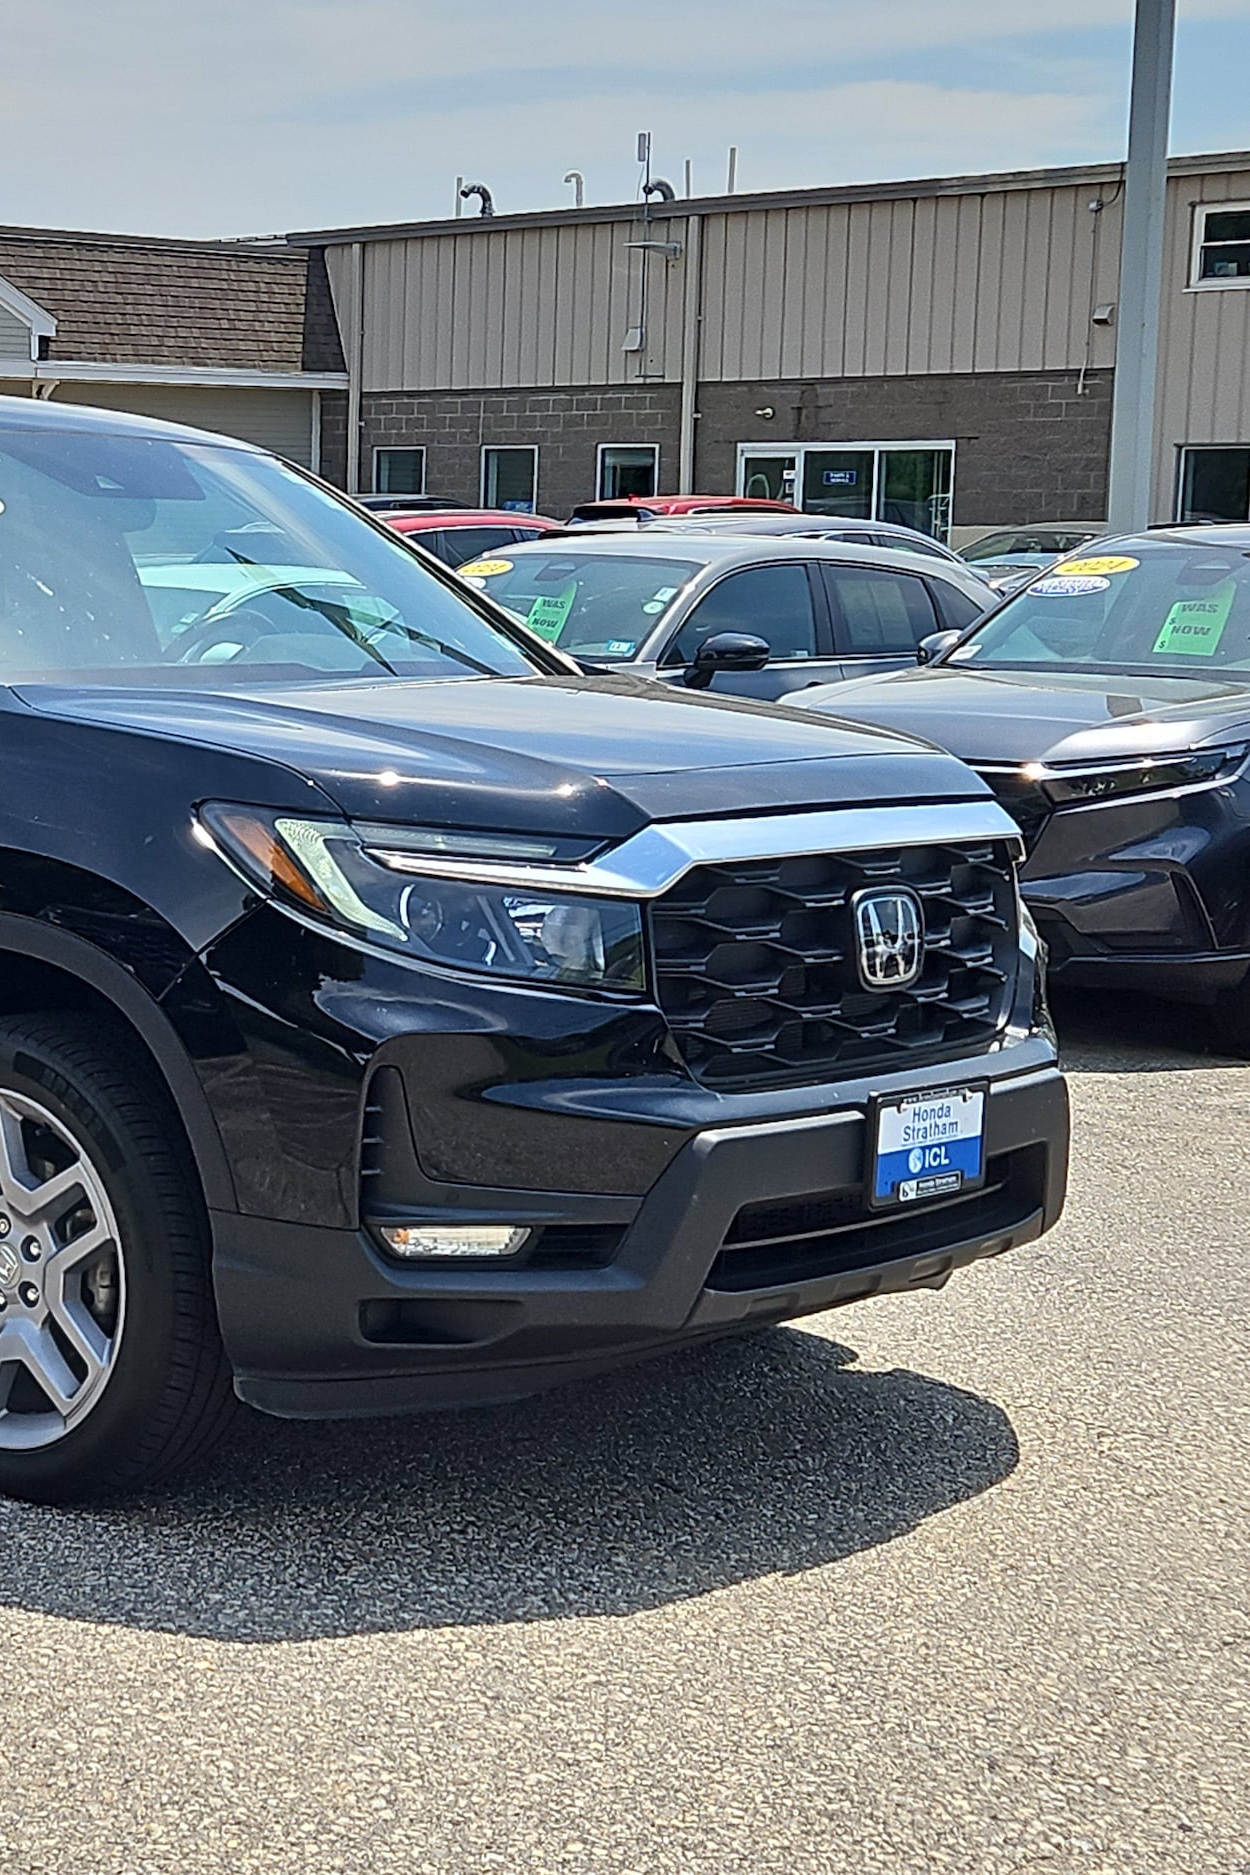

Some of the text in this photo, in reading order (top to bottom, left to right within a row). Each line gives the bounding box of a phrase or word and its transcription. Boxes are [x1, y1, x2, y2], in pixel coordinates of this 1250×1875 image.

[541, 599, 566, 609] WAS
[1181, 603, 1219, 613] WAS
[532, 617, 558, 628] NOW
[1171, 625, 1211, 635] NOW
[912, 1102, 951, 1123] Honda
[903, 1121, 959, 1142] Stratham
[925, 1145, 949, 1168] ICL
